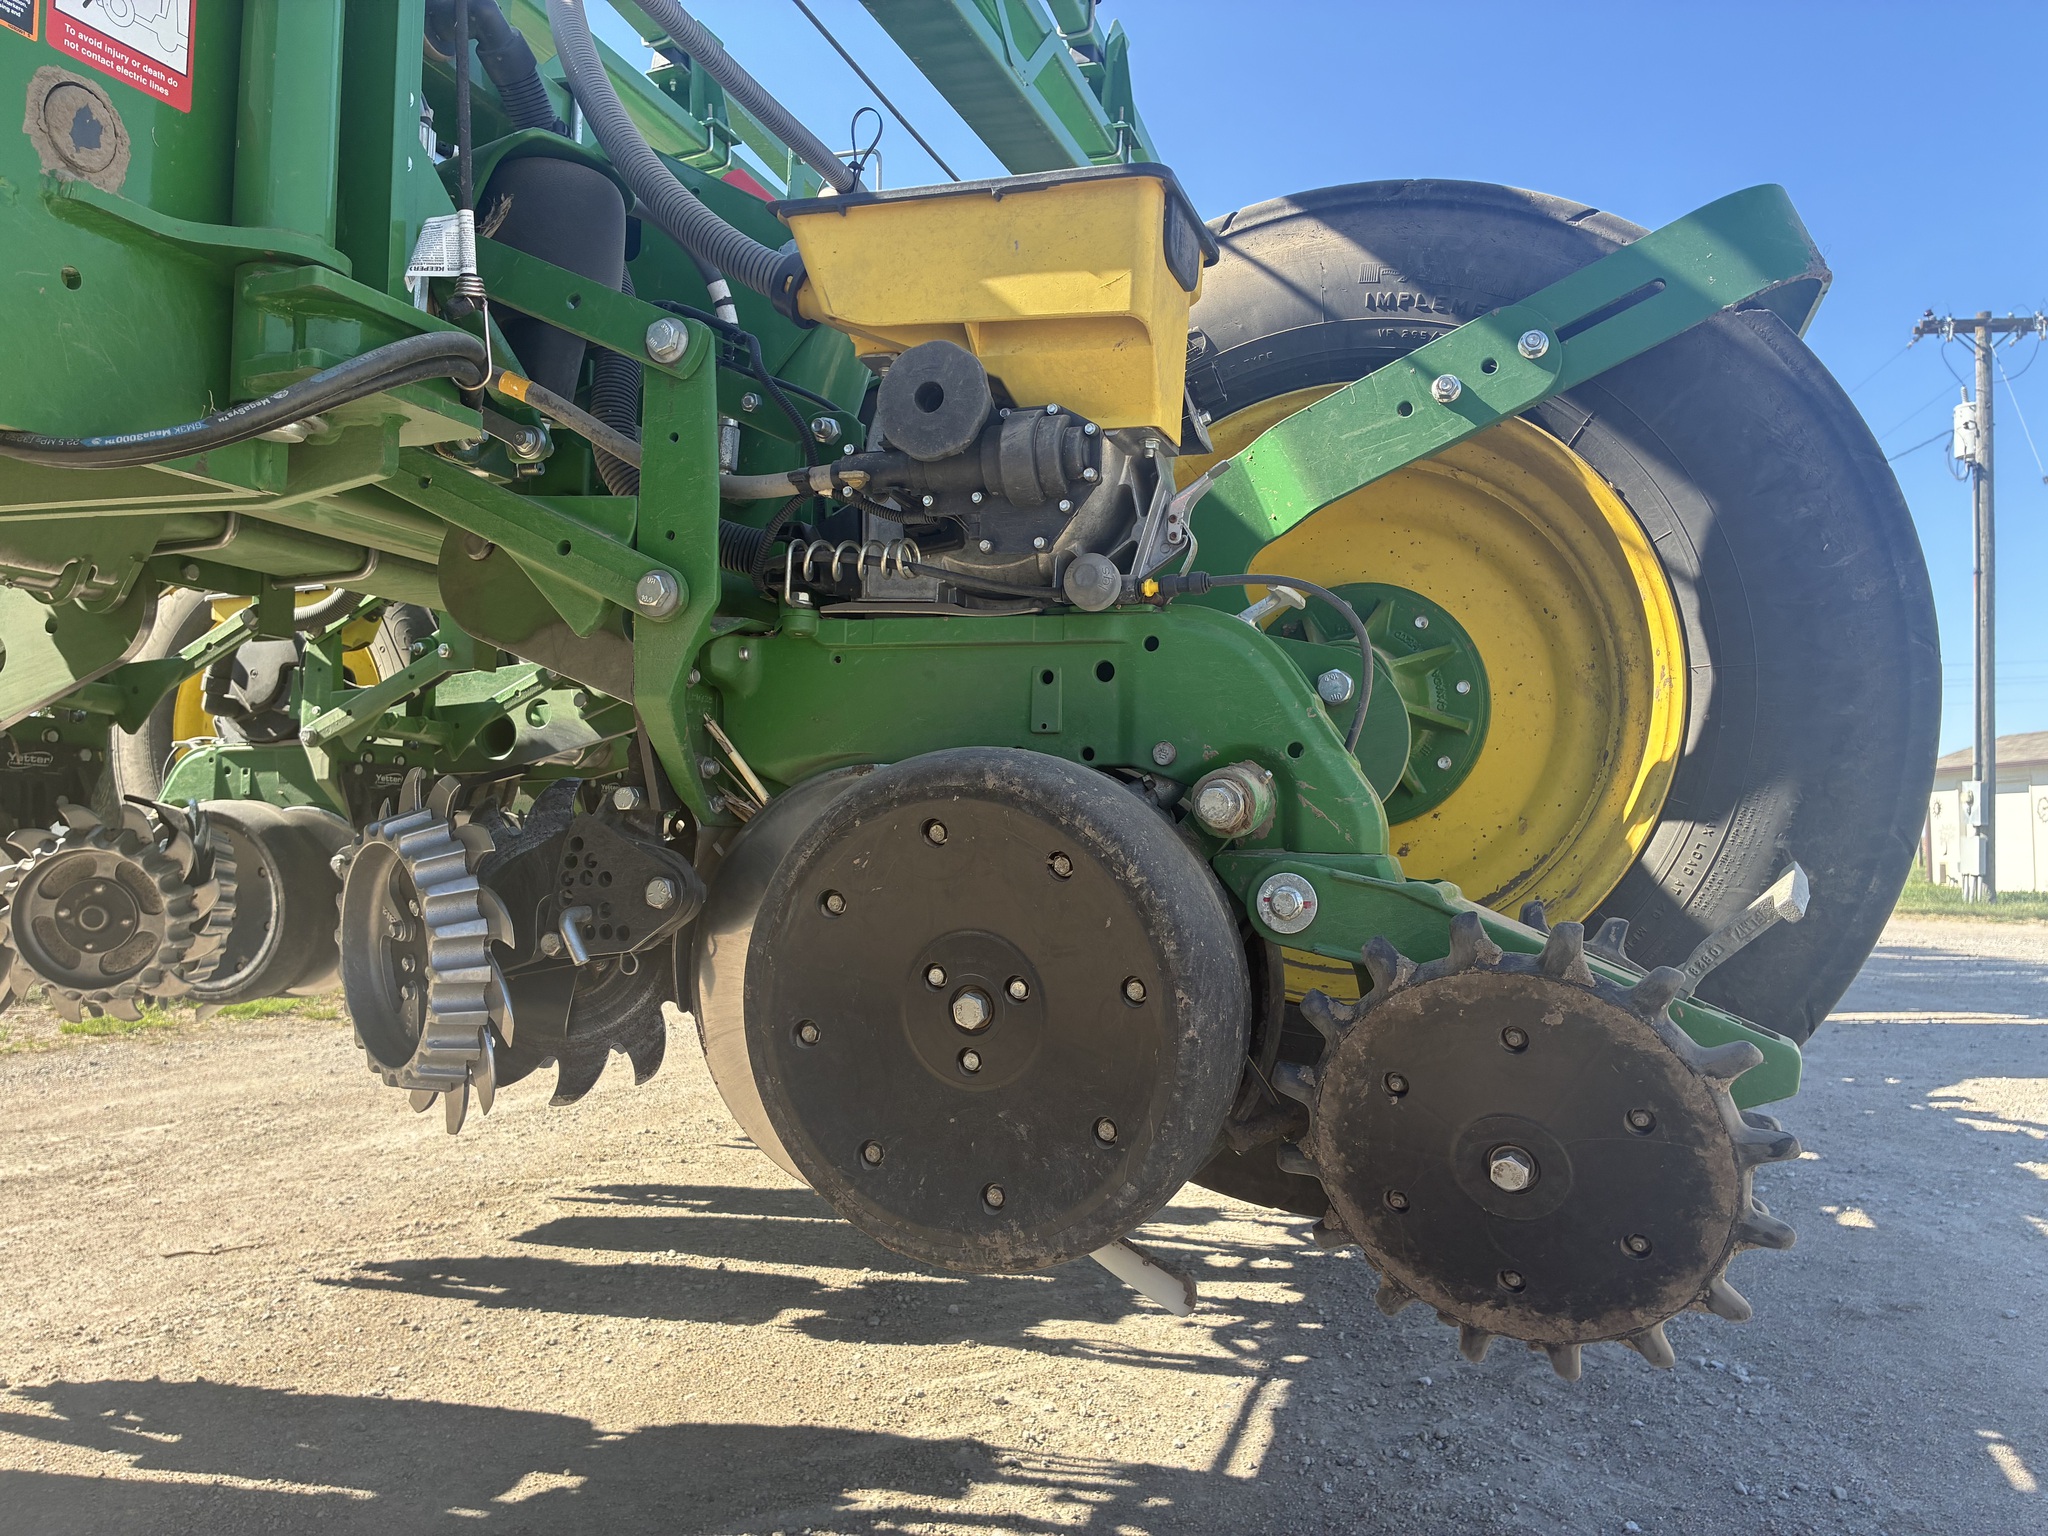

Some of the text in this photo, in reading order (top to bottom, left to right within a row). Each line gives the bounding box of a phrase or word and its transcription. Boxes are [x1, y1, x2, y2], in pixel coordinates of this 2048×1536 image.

[63, 38, 169, 96] not contact electric lines
[64, 23, 178, 88] To avoid injury or death do
[1364, 291, 1490, 316] IMPLEME
[1400, 329, 1445, 342] 295/
[1702, 810, 1720, 838] MAX
[1683, 842, 1708, 876] LOAD
[1671, 877, 1685, 896] AT
